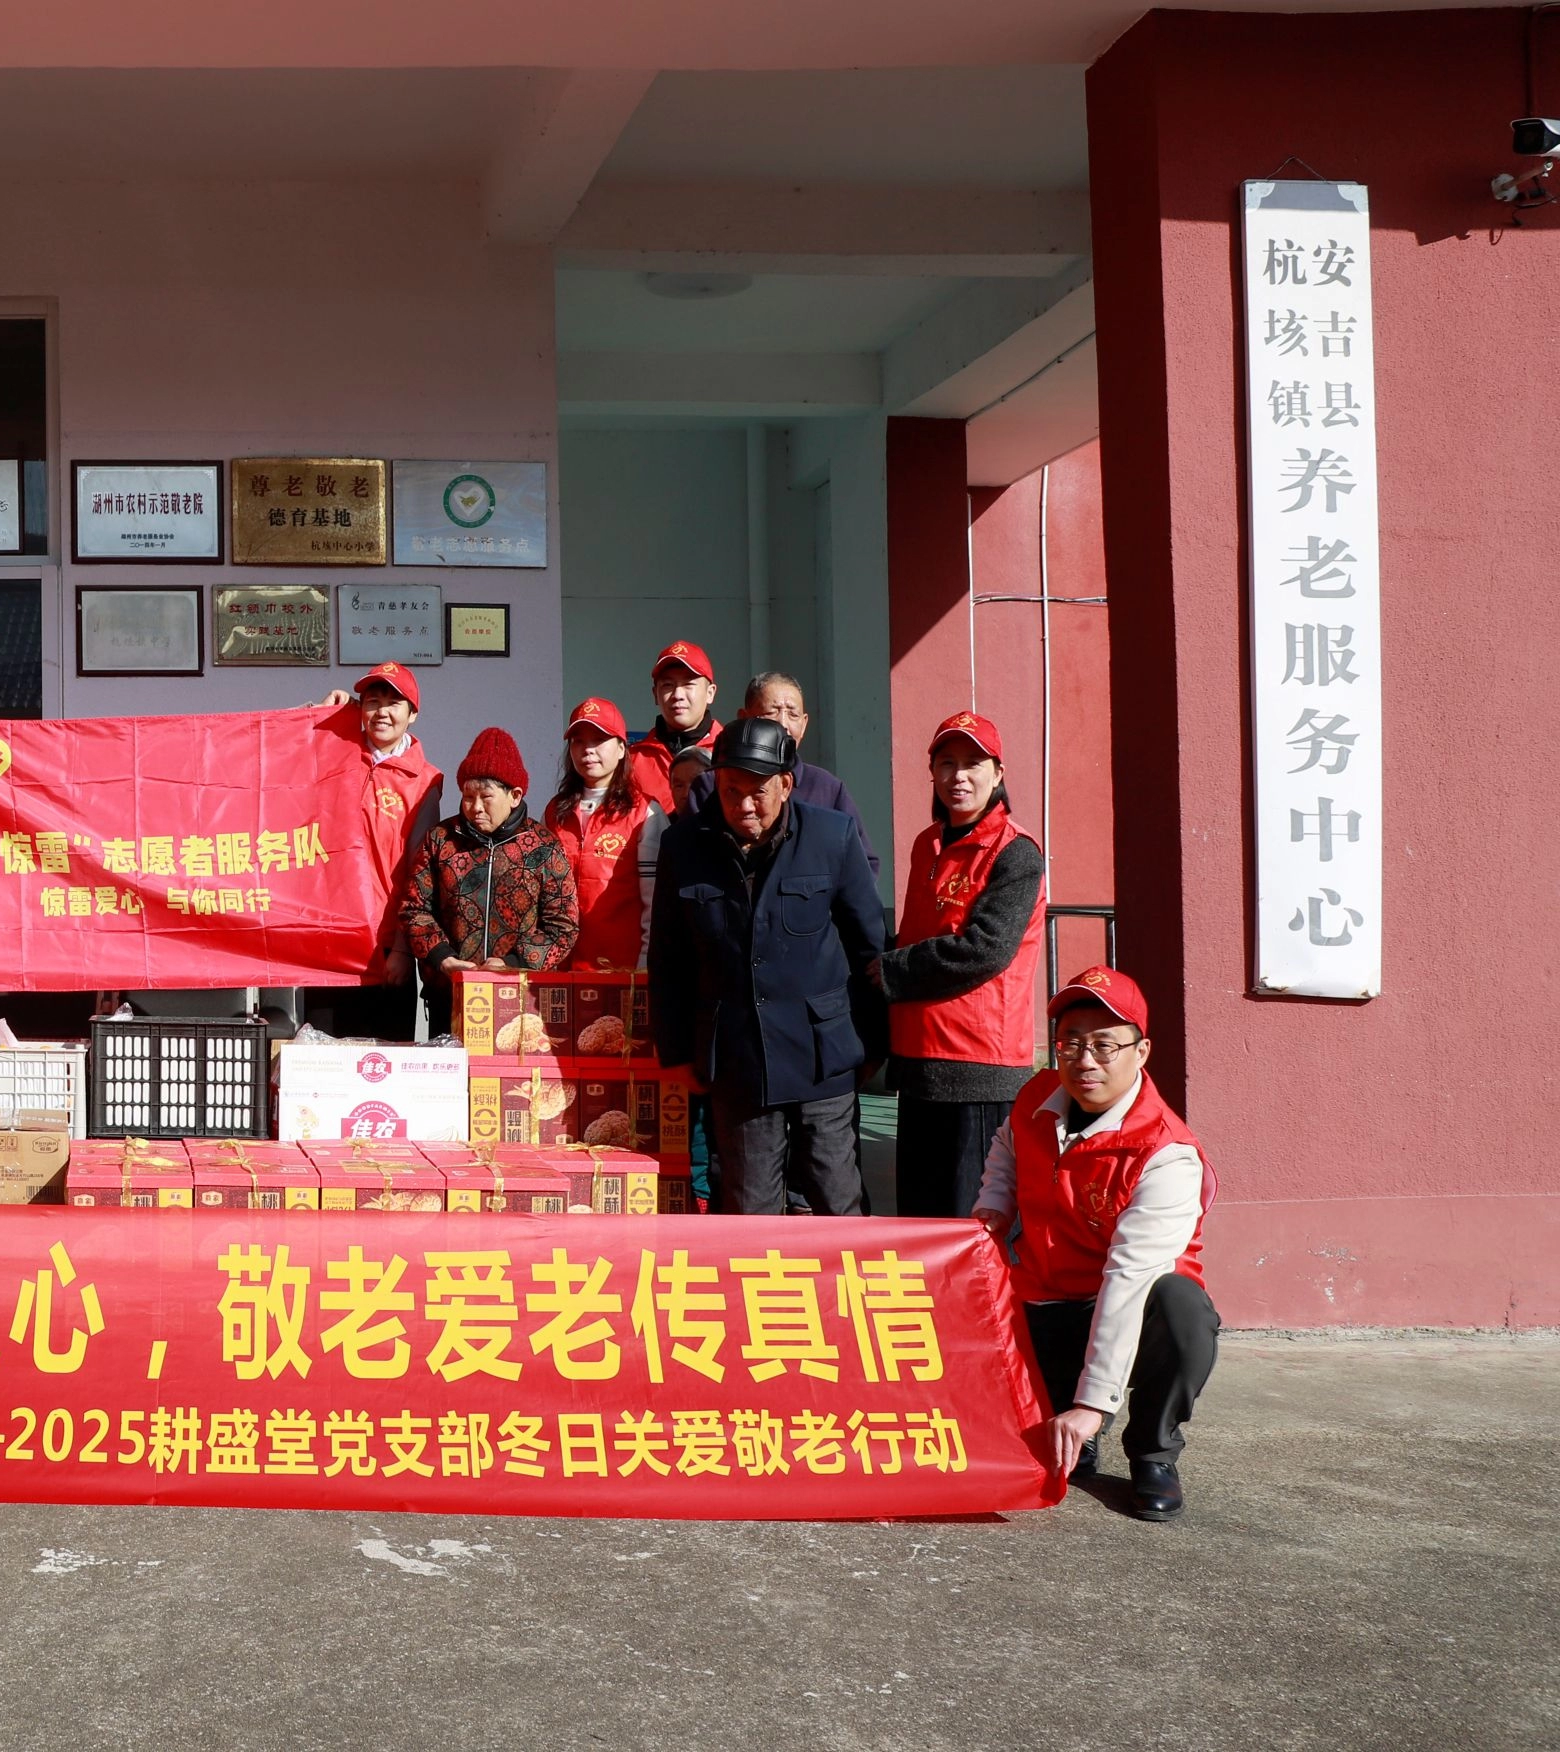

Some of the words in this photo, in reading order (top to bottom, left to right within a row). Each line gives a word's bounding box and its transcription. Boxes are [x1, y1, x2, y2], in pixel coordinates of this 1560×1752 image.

[1262, 237, 1313, 429] 杭垓镇
[1312, 238, 1362, 429] 安吉县
[249, 475, 370, 498] 尊老敬老
[92, 492, 204, 515] 湖州市农村示范敬老院
[268, 508, 352, 527] 德育基地
[311, 540, 376, 552] 杭垓中心小学
[228, 603, 313, 614] 红领巾校外
[244, 626, 300, 636] 实践基地
[351, 625, 430, 637] 敬老服务点
[1278, 446, 1365, 949] 养老服务中心
[40, 887, 143, 916] 惊雷爱心
[167, 888, 271, 914] 与你同行
[550, 988, 566, 1023] 桃酥
[466, 1027, 490, 1039] 桃酥
[361, 1061, 387, 1074] 佳农
[638, 1085, 654, 1120] 桃酥
[350, 1119, 398, 1139] 佳农
[663, 1125, 687, 1137] 桃酥
[262, 1194, 279, 1209] 桃
[544, 1198, 561, 1213] 桃
[604, 1179, 620, 1214] 桃酥
